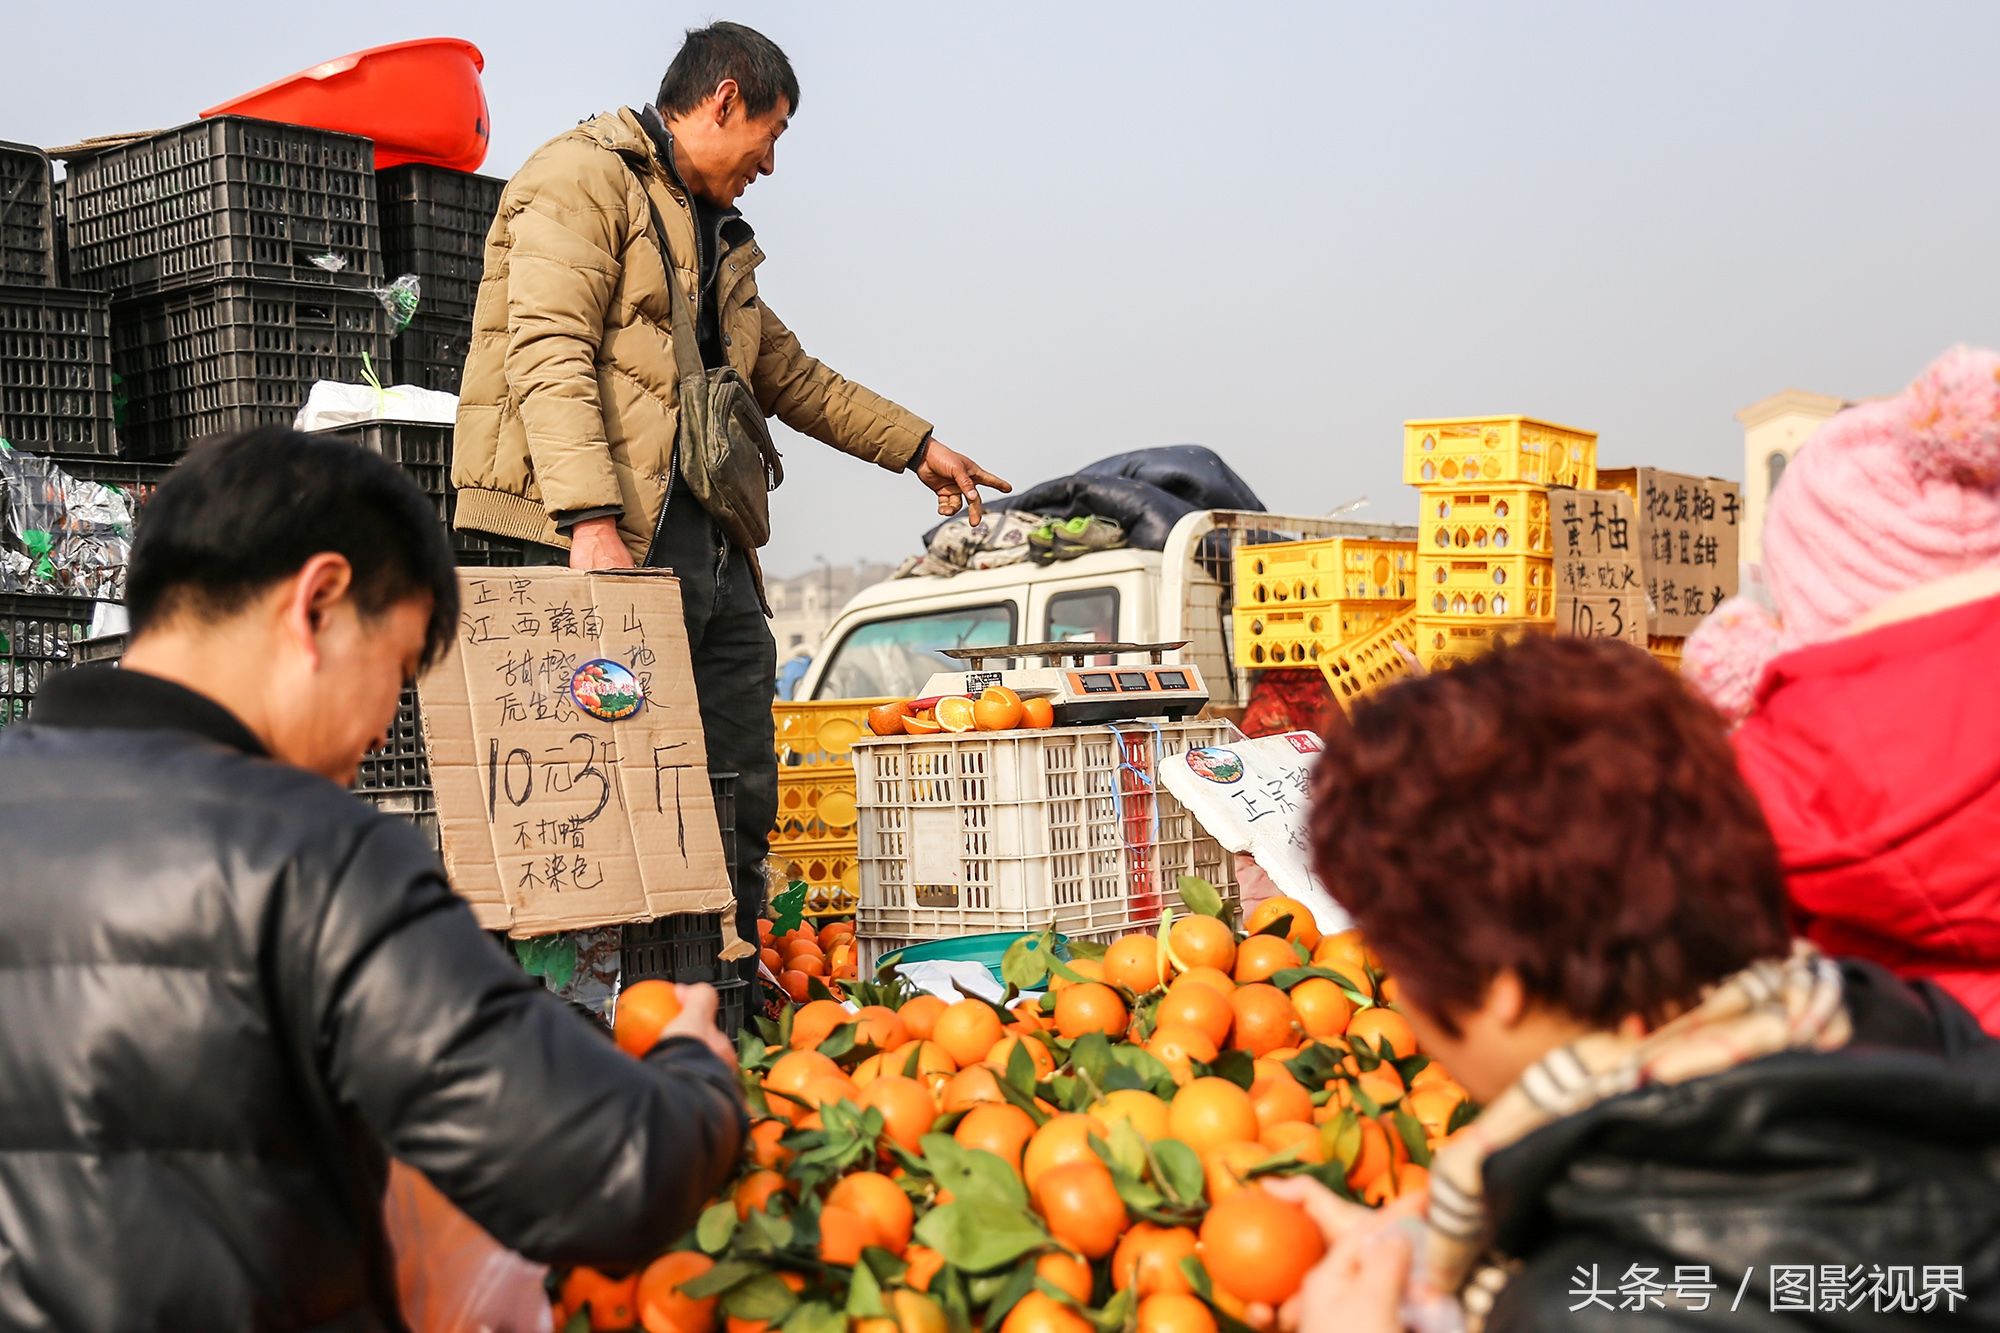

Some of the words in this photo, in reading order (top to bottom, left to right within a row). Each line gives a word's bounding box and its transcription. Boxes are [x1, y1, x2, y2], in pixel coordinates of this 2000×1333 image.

[469, 575, 536, 605] 正宗
[462, 600, 605, 646] 江西赣南
[518, 853, 604, 892] 不染色
